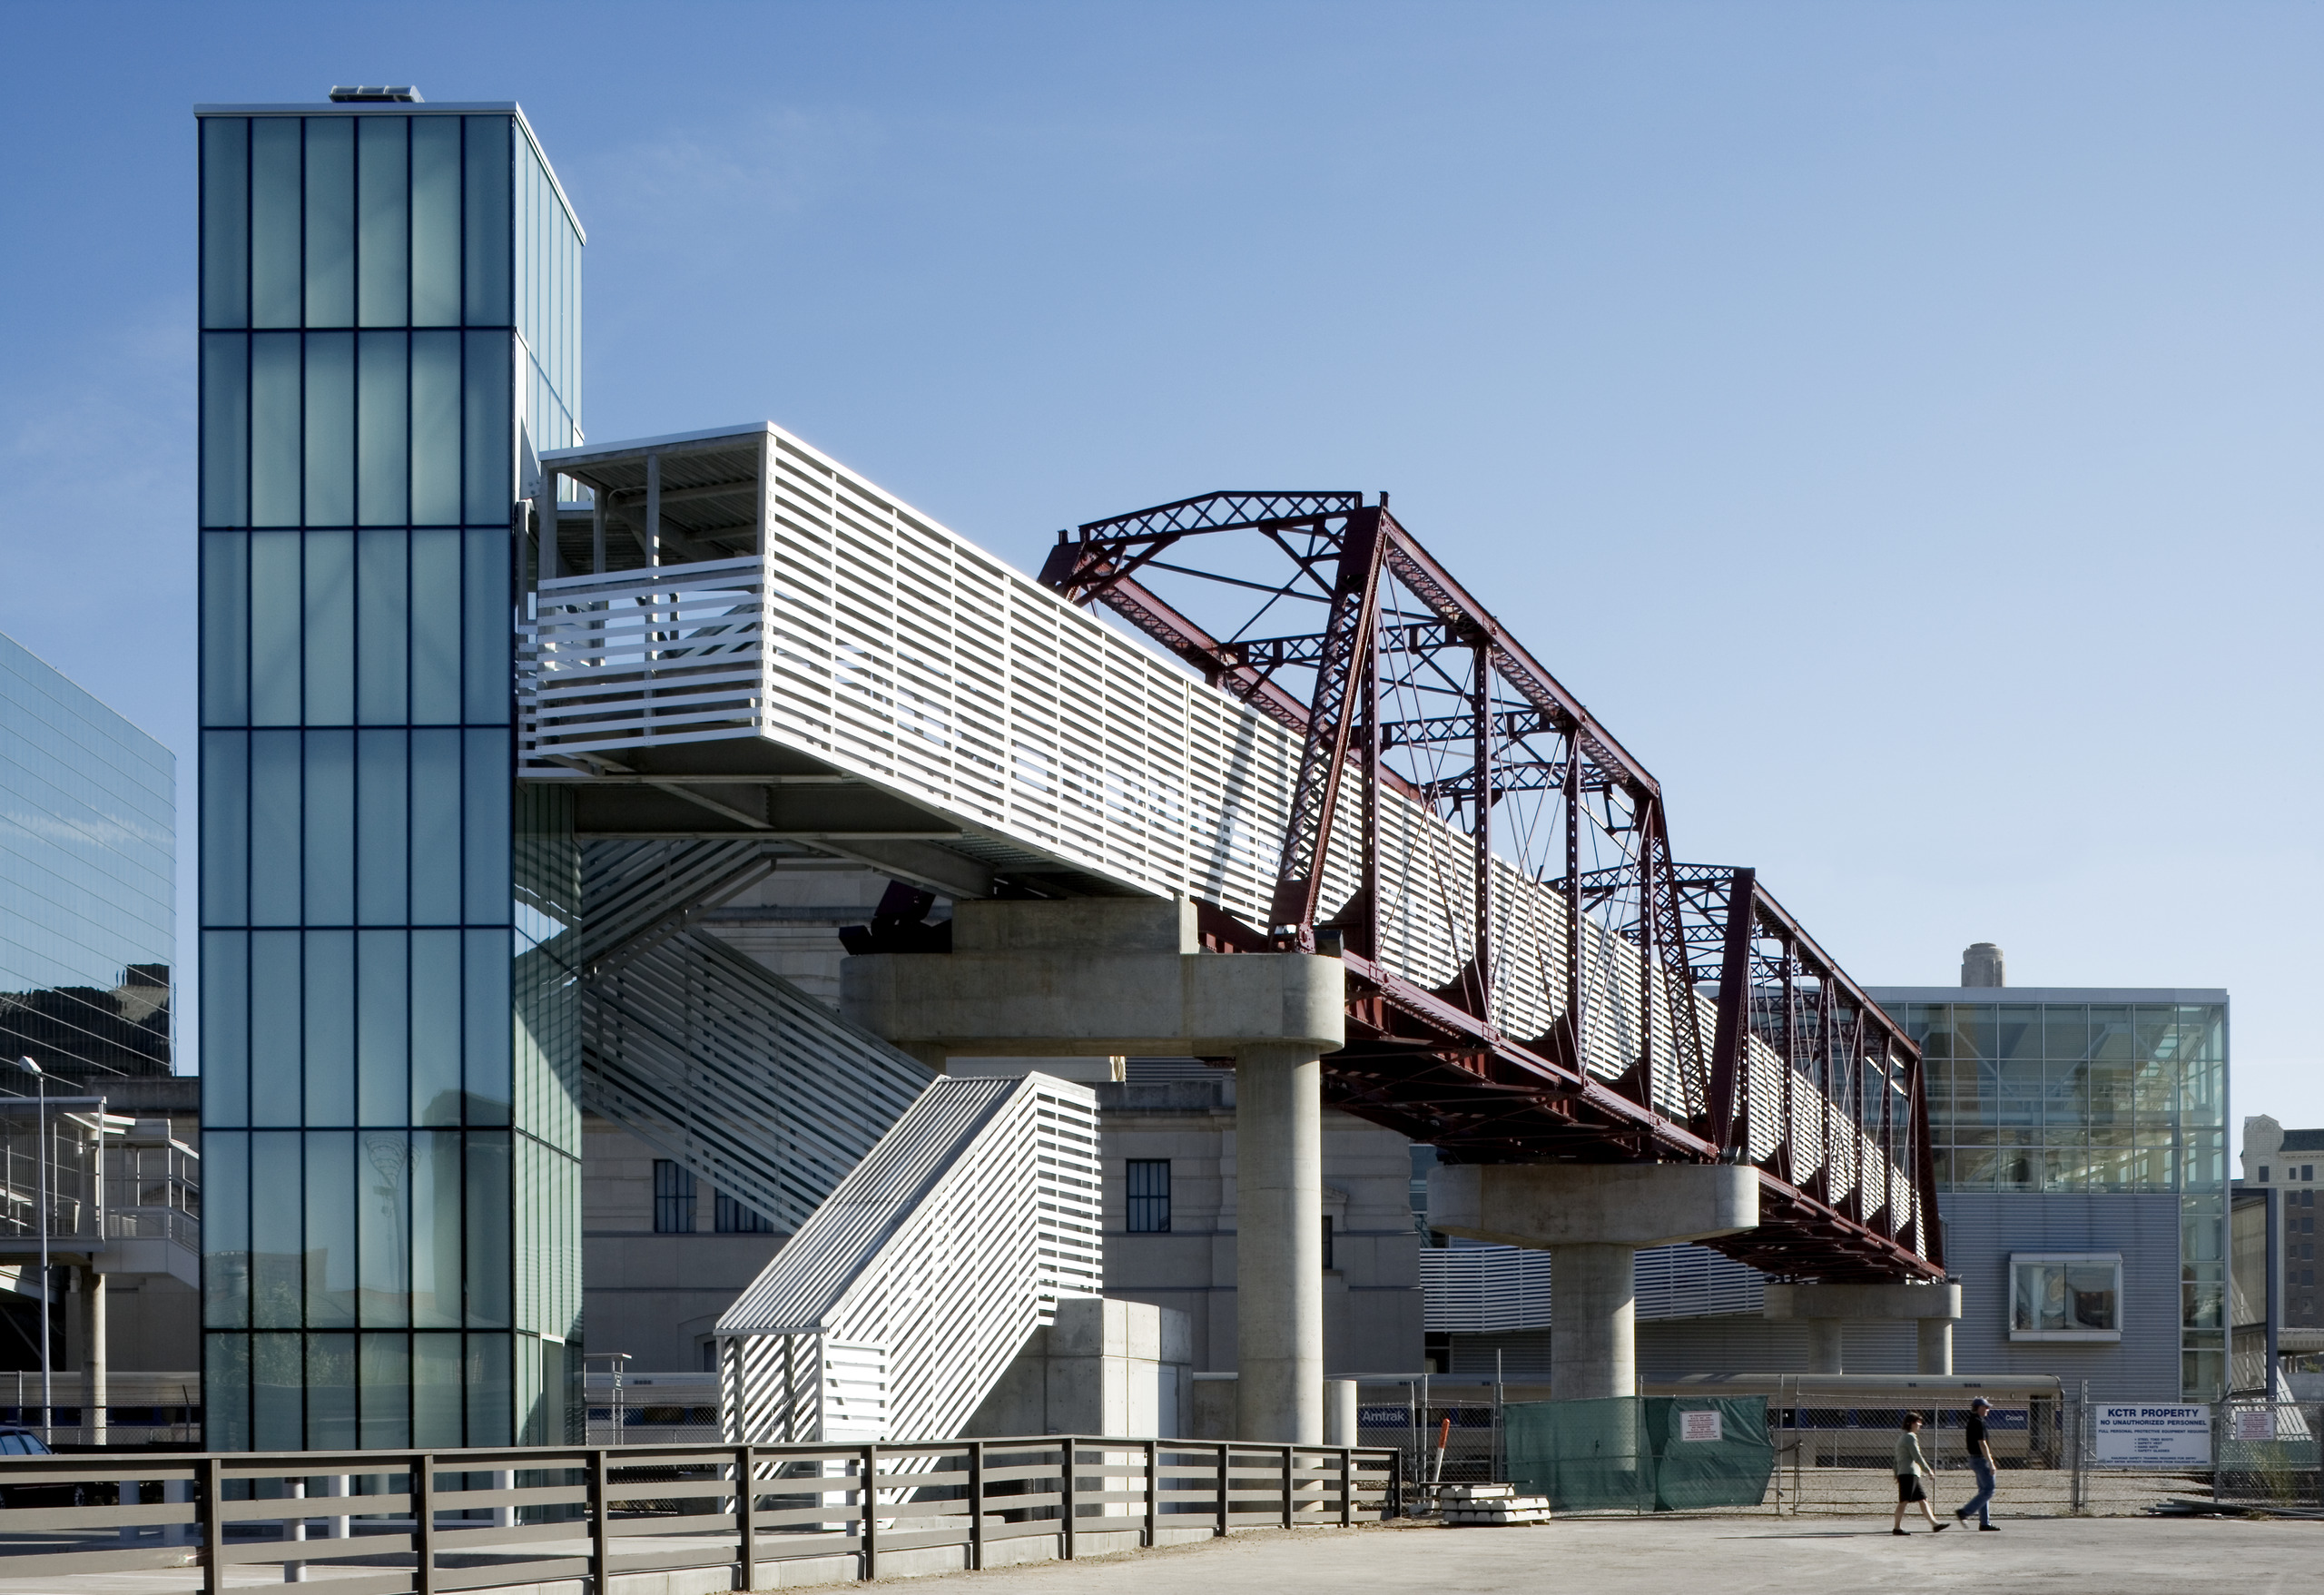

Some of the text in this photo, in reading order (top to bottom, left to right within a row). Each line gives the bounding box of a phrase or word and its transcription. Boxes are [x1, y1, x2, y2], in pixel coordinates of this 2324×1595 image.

[1362, 1411, 1405, 1421] Amtrak
[2108, 1408, 2199, 1417] KCTR PROPERTY
